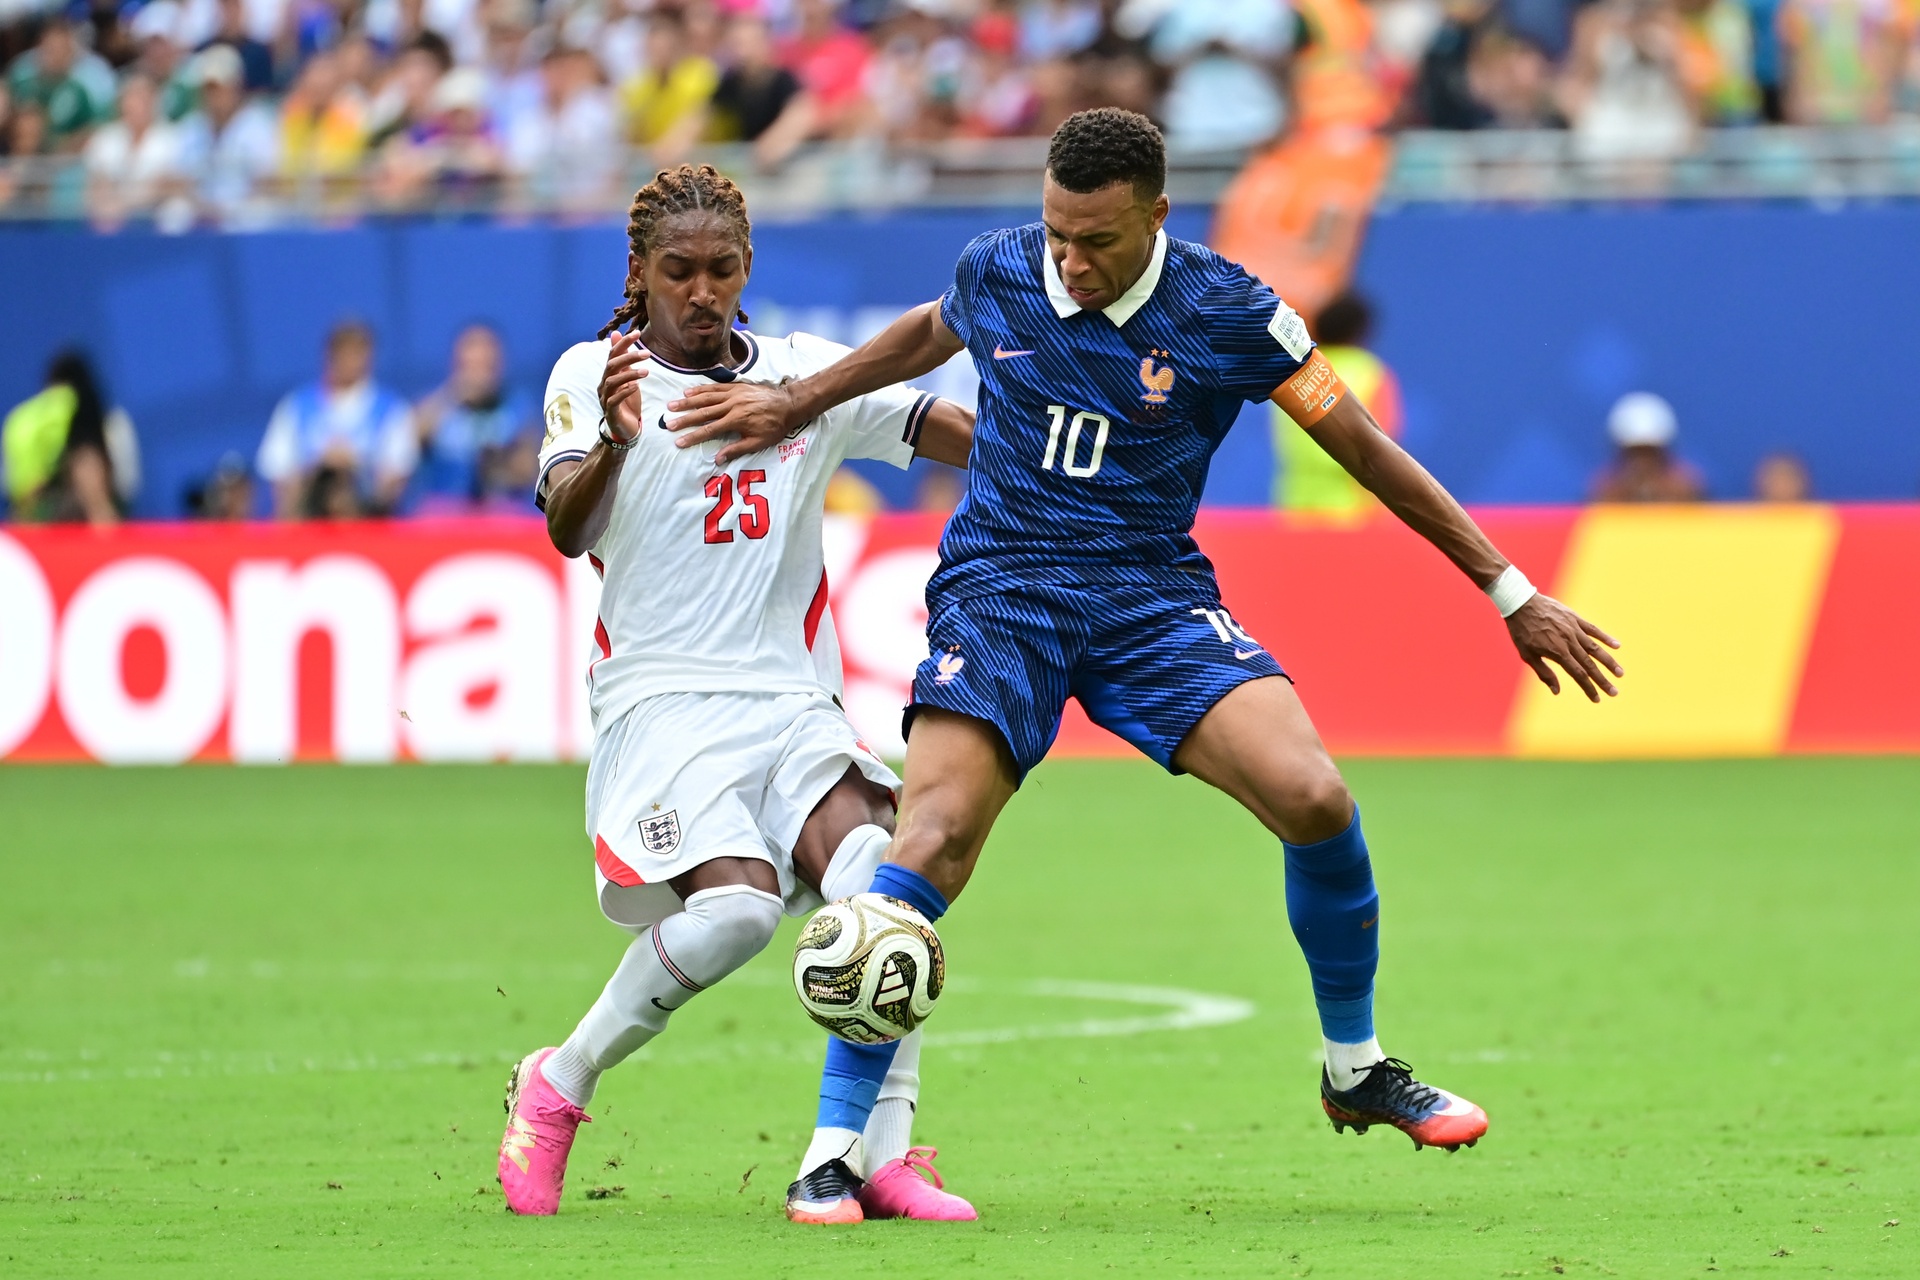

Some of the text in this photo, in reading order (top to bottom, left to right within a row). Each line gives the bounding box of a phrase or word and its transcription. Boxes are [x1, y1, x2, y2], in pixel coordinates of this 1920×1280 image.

[1290, 359, 1321, 392] FOOTBALL
[1295, 363, 1330, 401] UNITES
[1303, 372, 1338, 412] the World
[1322, 395, 1336, 409] FIFA
[777, 437, 807, 454] FRANCE
[1041, 404, 1111, 478] 10
[703, 468, 771, 545] 25
[808, 984, 834, 994] FINAL
[808, 990, 851, 1000] TRIONDA
